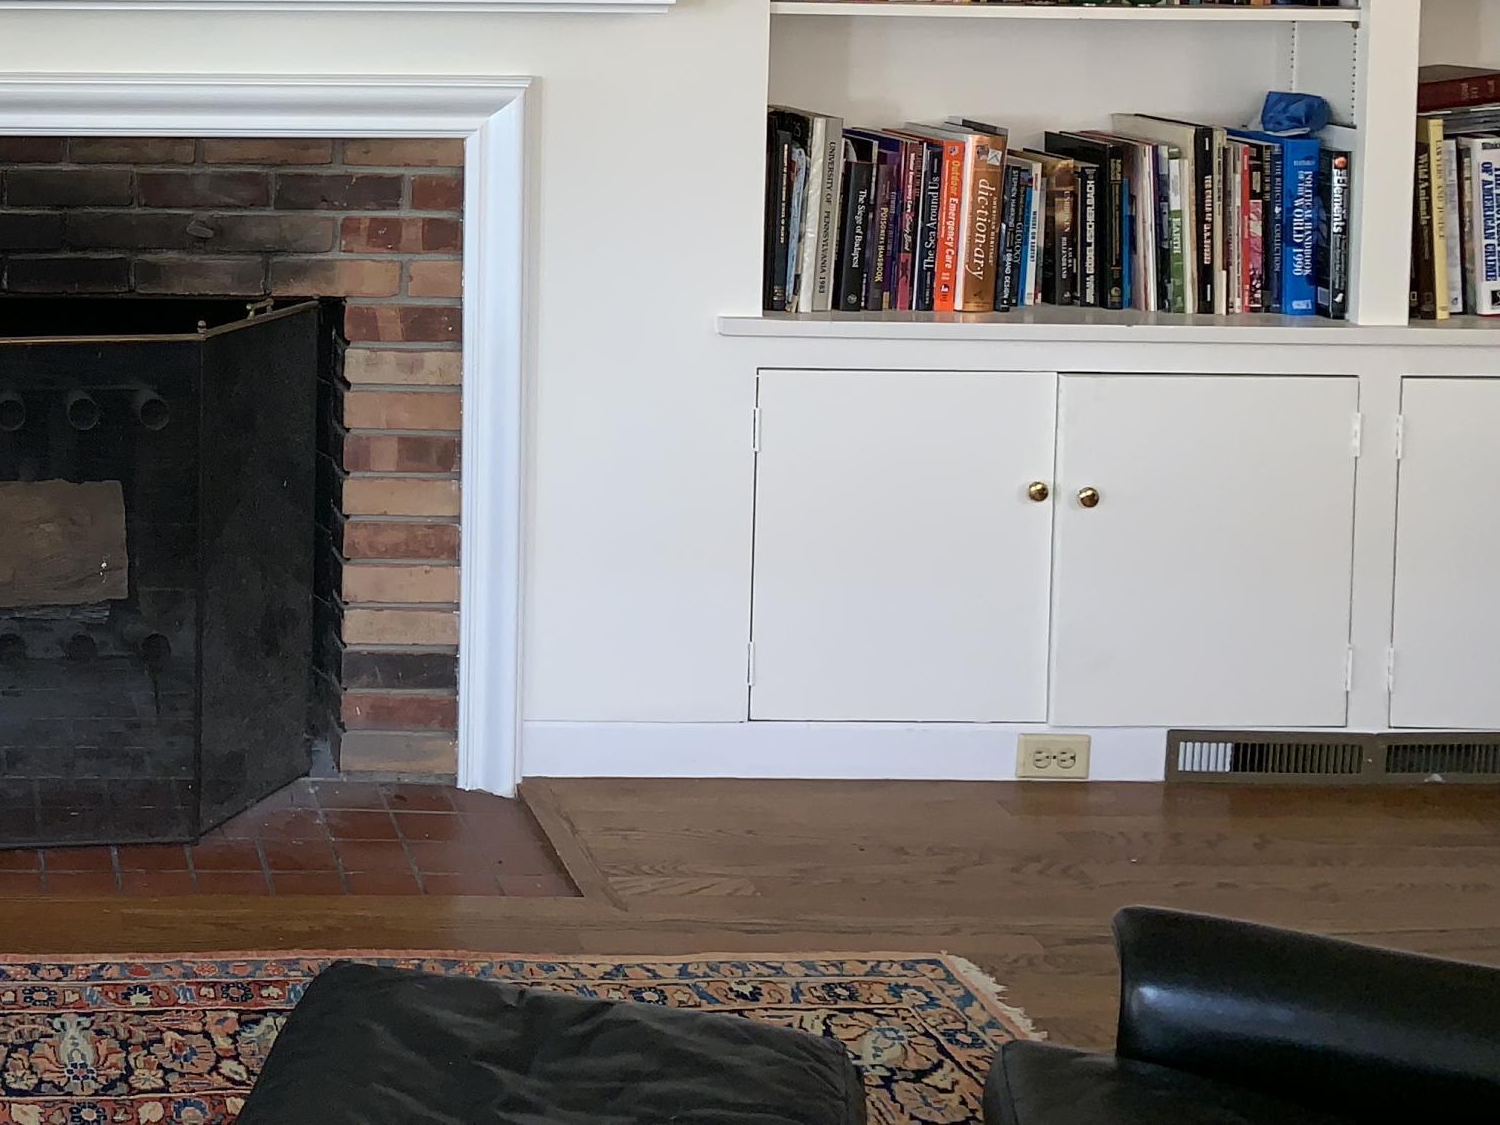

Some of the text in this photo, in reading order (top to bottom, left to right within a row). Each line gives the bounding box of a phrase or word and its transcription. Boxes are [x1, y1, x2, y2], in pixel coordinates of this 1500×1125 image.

[945, 160, 961, 269] Outdoor Emergency Care
[1010, 170, 1018, 198] STEPHEN
[1333, 176, 1344, 233] Elements
[1418, 153, 1430, 225] Wild Animals
[818, 141, 836, 294] UNIVERSITY OF PENNSYLVANIA 1983
[851, 189, 867, 268] The Siege of Budapest
[923, 176, 939, 270] The Sea Around Us
[1013, 222, 1024, 265] GEOLOGY
[1171, 218, 1181, 254] EARTH
[1293, 198, 1304, 243] WORLD
[1304, 171, 1313, 276] POLITICAL HANDBOOK
[1481, 162, 1497, 281] OF AMERICAN CRIME
[874, 245, 884, 283] HANDBOOK
[1293, 247, 1303, 276] 1990
